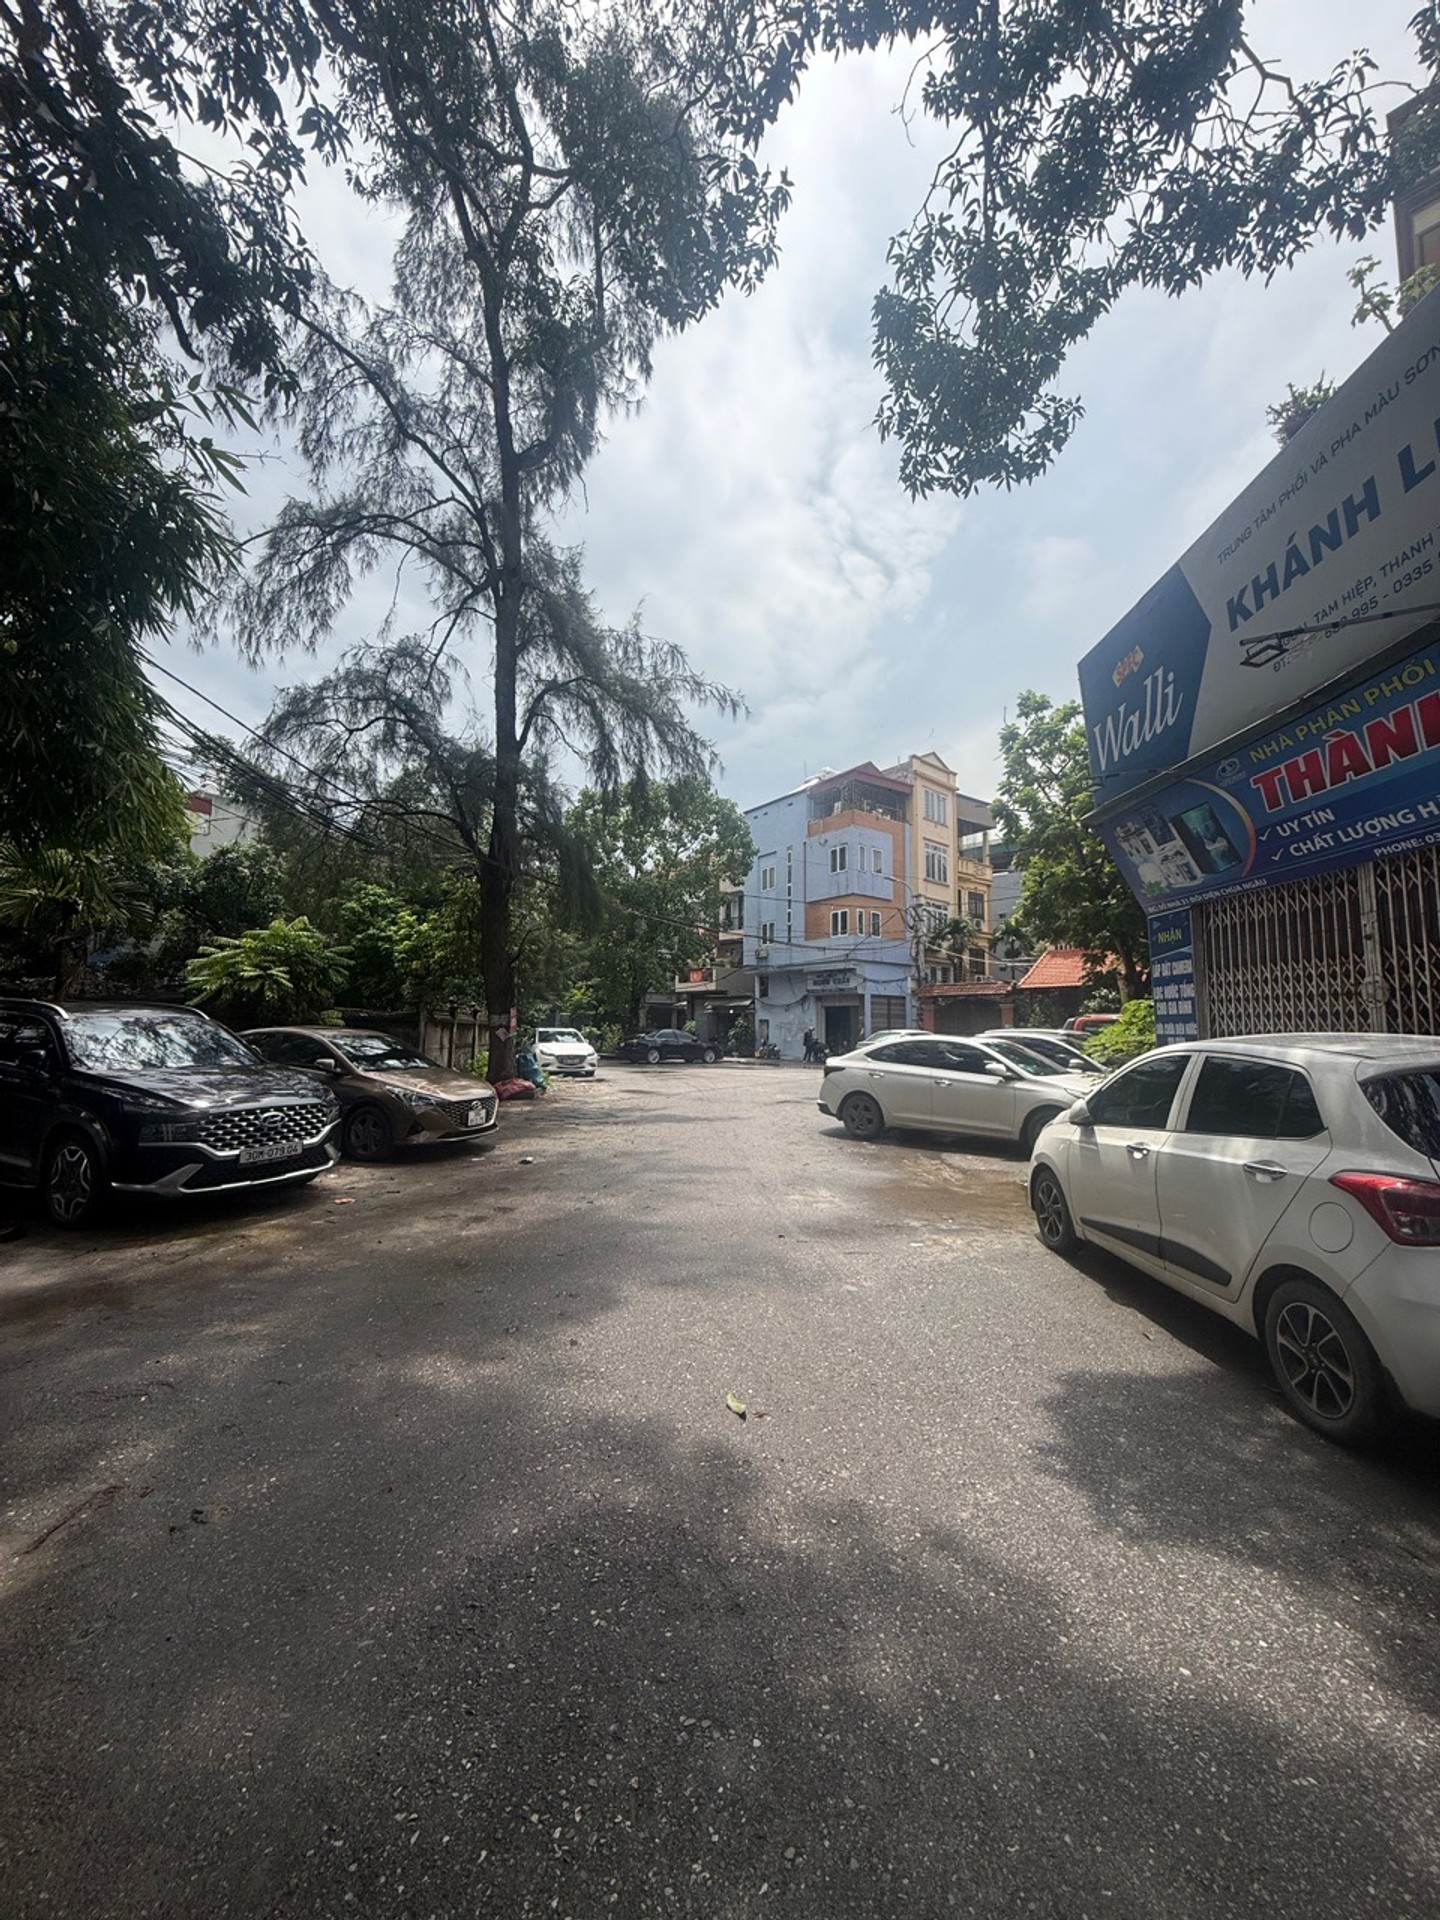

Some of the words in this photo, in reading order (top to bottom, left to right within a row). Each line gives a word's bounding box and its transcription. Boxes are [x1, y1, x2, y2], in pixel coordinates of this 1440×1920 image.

[1217, 526, 1253, 564] TRUNG
[1253, 502, 1277, 529] TÂM
[1310, 451, 1328, 475] VÀ
[1331, 422, 1362, 457] PHA
[1364, 381, 1400, 425] MÀU
[1226, 475, 1382, 633] KHÁNH
[1341, 575, 1377, 605] HIỆP,
[1379, 532, 1434, 577] THANH
[1393, 559, 1433, 594] 0335
[1093, 665, 1183, 771] Walli
[1249, 733, 1294, 763] NHÀ
[1295, 699, 1362, 740] PHÂN
[1363, 658, 1436, 706] PHỐI
[1276, 819, 1300, 837] UY
[1301, 808, 1336, 829] TÍN
[1290, 832, 1336, 857] CHẤT
[1337, 808, 1416, 844] LƯỢNG
[1374, 837, 1424, 857] PHONE:
[1158, 927, 1182, 944] NHẬN
